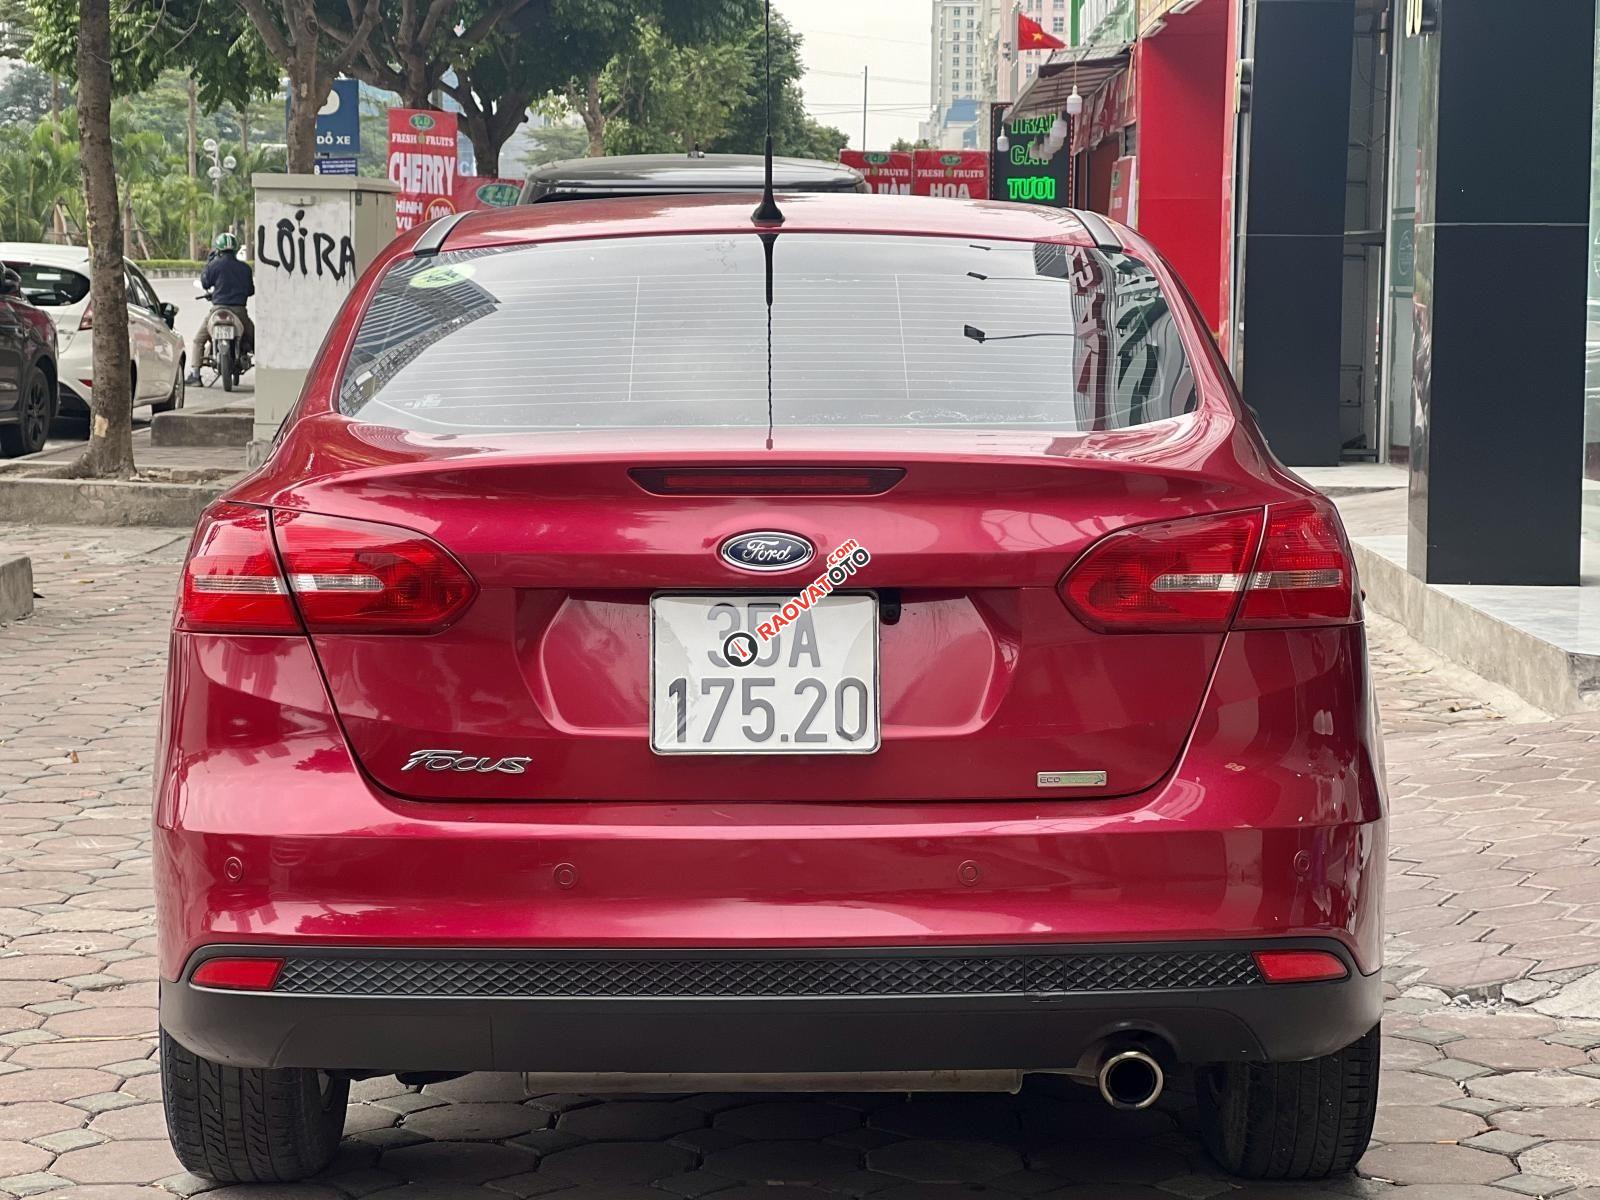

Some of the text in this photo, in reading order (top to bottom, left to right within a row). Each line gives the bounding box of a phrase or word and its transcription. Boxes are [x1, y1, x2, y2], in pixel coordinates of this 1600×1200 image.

[336, 136, 351, 145] XE
[391, 133, 455, 147] FRESH FRUITS
[388, 152, 456, 196] CHERRY
[879, 168, 909, 177] FRUITS
[917, 169, 985, 178] FRESH FRUITS
[1007, 176, 1056, 200] TƯƠI
[313, 232, 356, 281] RA
[743, 540, 791, 560] Ford
[707, 603, 821, 668] 35A
[668, 677, 868, 743] 175.20
